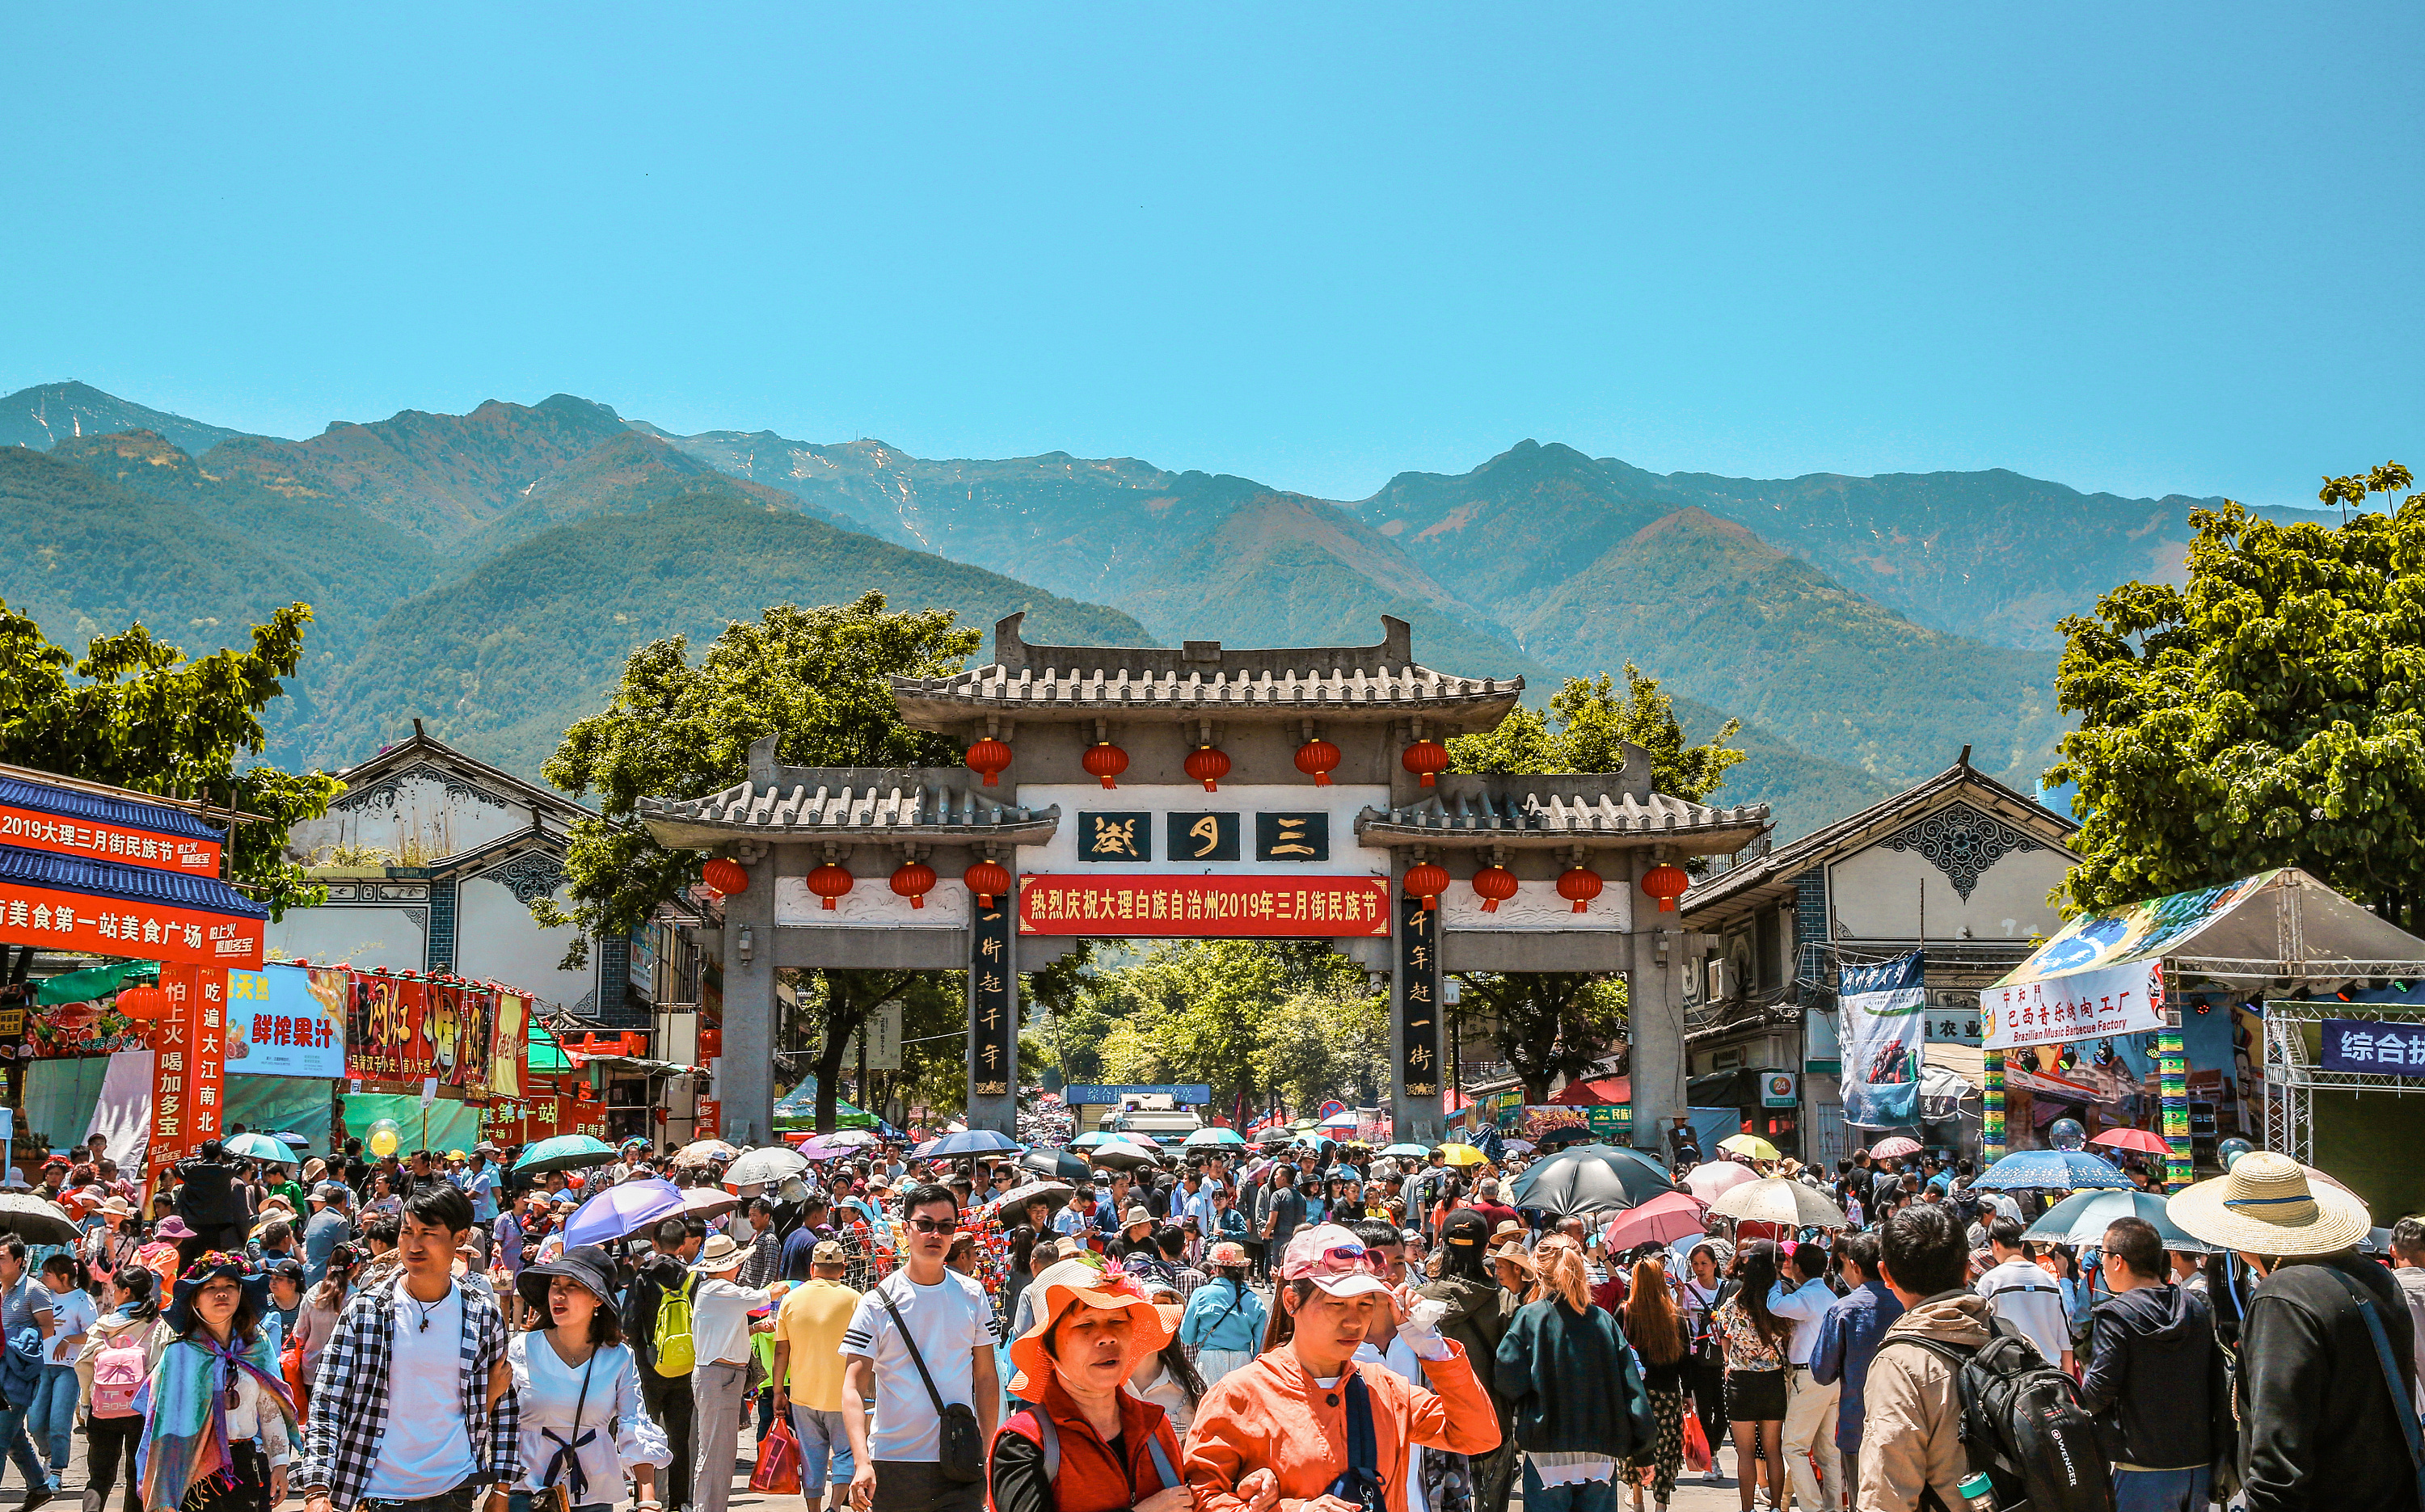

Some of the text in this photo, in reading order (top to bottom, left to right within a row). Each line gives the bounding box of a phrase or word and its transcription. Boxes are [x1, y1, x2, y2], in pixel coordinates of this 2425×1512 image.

[2, 815, 174, 862] 2019大理三月街民族节
[1031, 888, 1377, 923] 热烈庆祝大理白族自治州2019年三月街民族节
[209, 923, 237, 941] 怕上火
[979, 912, 1003, 1071] 一街赶千年
[1409, 911, 1433, 1071] 千年赶一街
[2008, 991, 2130, 1028] 巴西音乐烤肉工厂
[80, 1034, 134, 1051] 水果沙冰
[251, 1013, 334, 1049] 鲜榨果汁
[2014, 1018, 2128, 1042] Brazilian Music Barbecue Factory
[197, 982, 221, 1133] 吃遍大江南北
[102, 1390, 120, 1399] TF
[2057, 1438, 2077, 1487] WENGER
